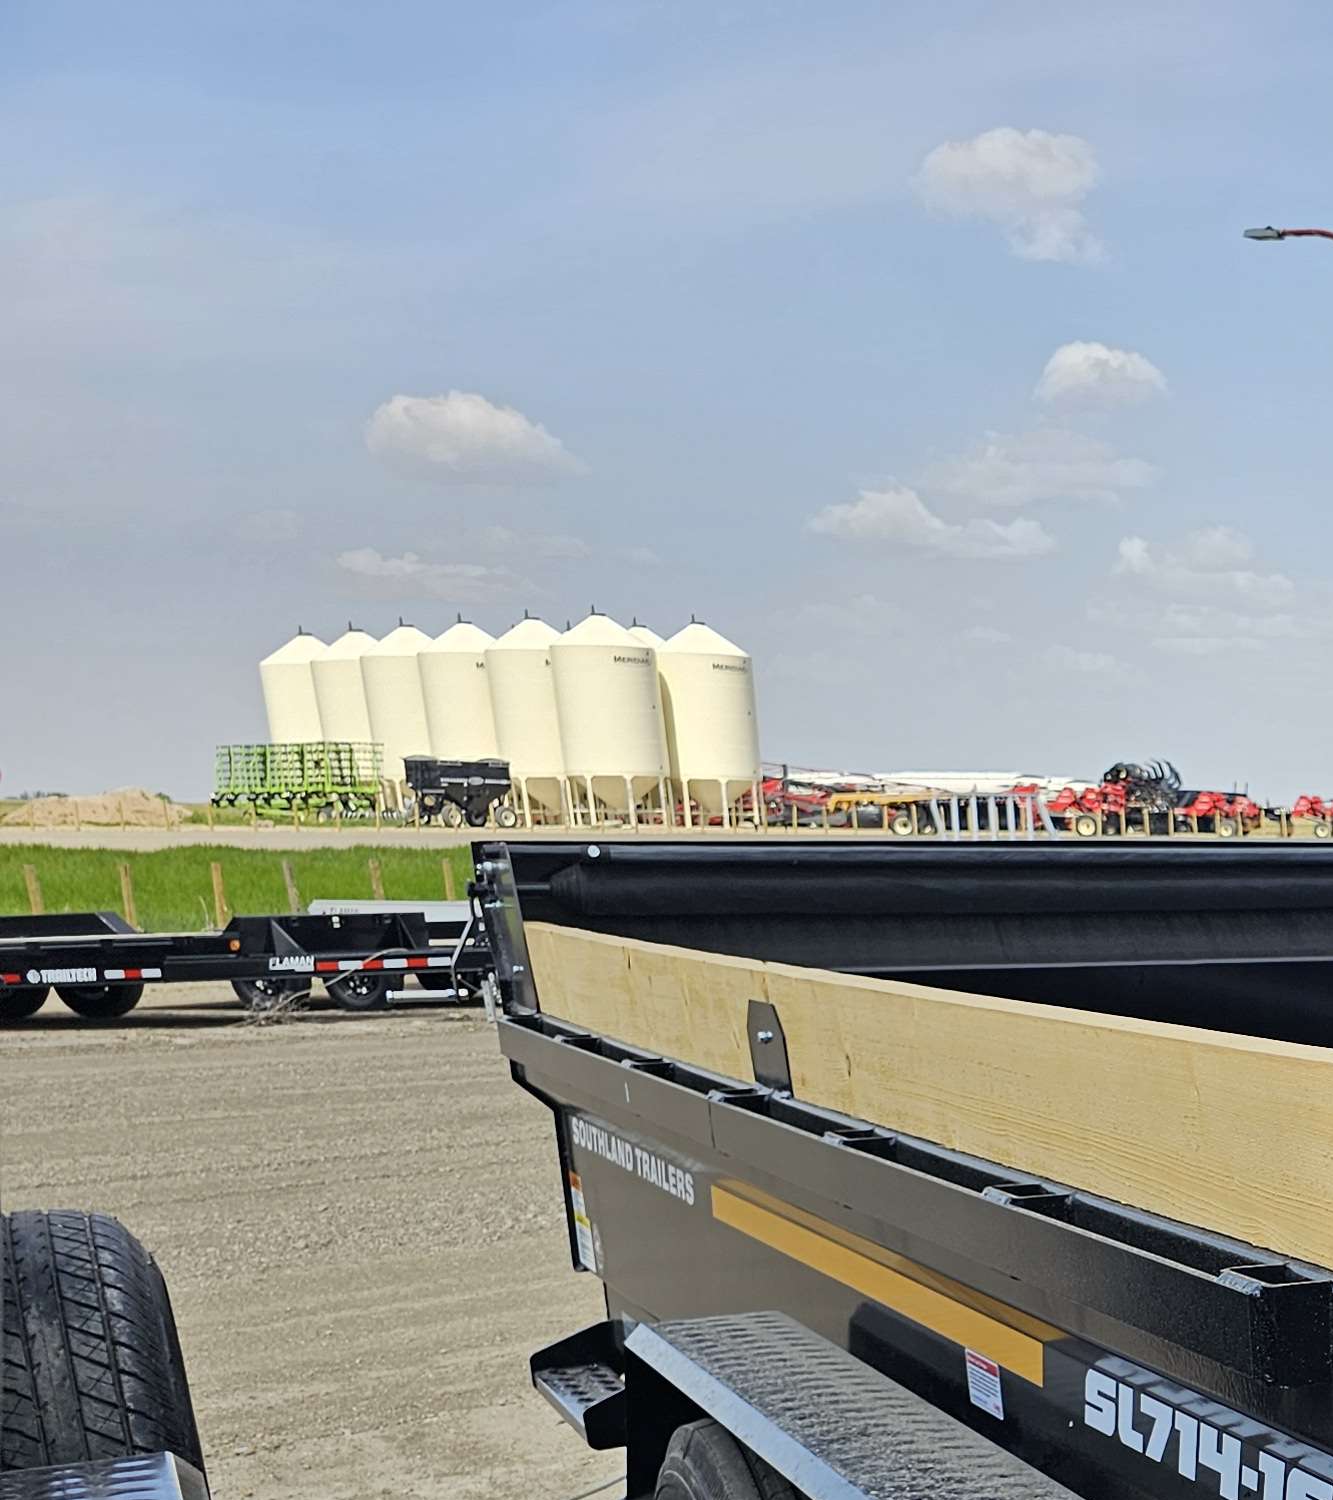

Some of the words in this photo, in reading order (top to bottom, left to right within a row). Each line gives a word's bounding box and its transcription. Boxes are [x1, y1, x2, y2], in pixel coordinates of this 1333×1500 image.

[269, 956, 314, 972] FLAMAN
[571, 1116, 633, 1172] SOUTHLAND
[635, 1148, 695, 1206] TRAILERS
